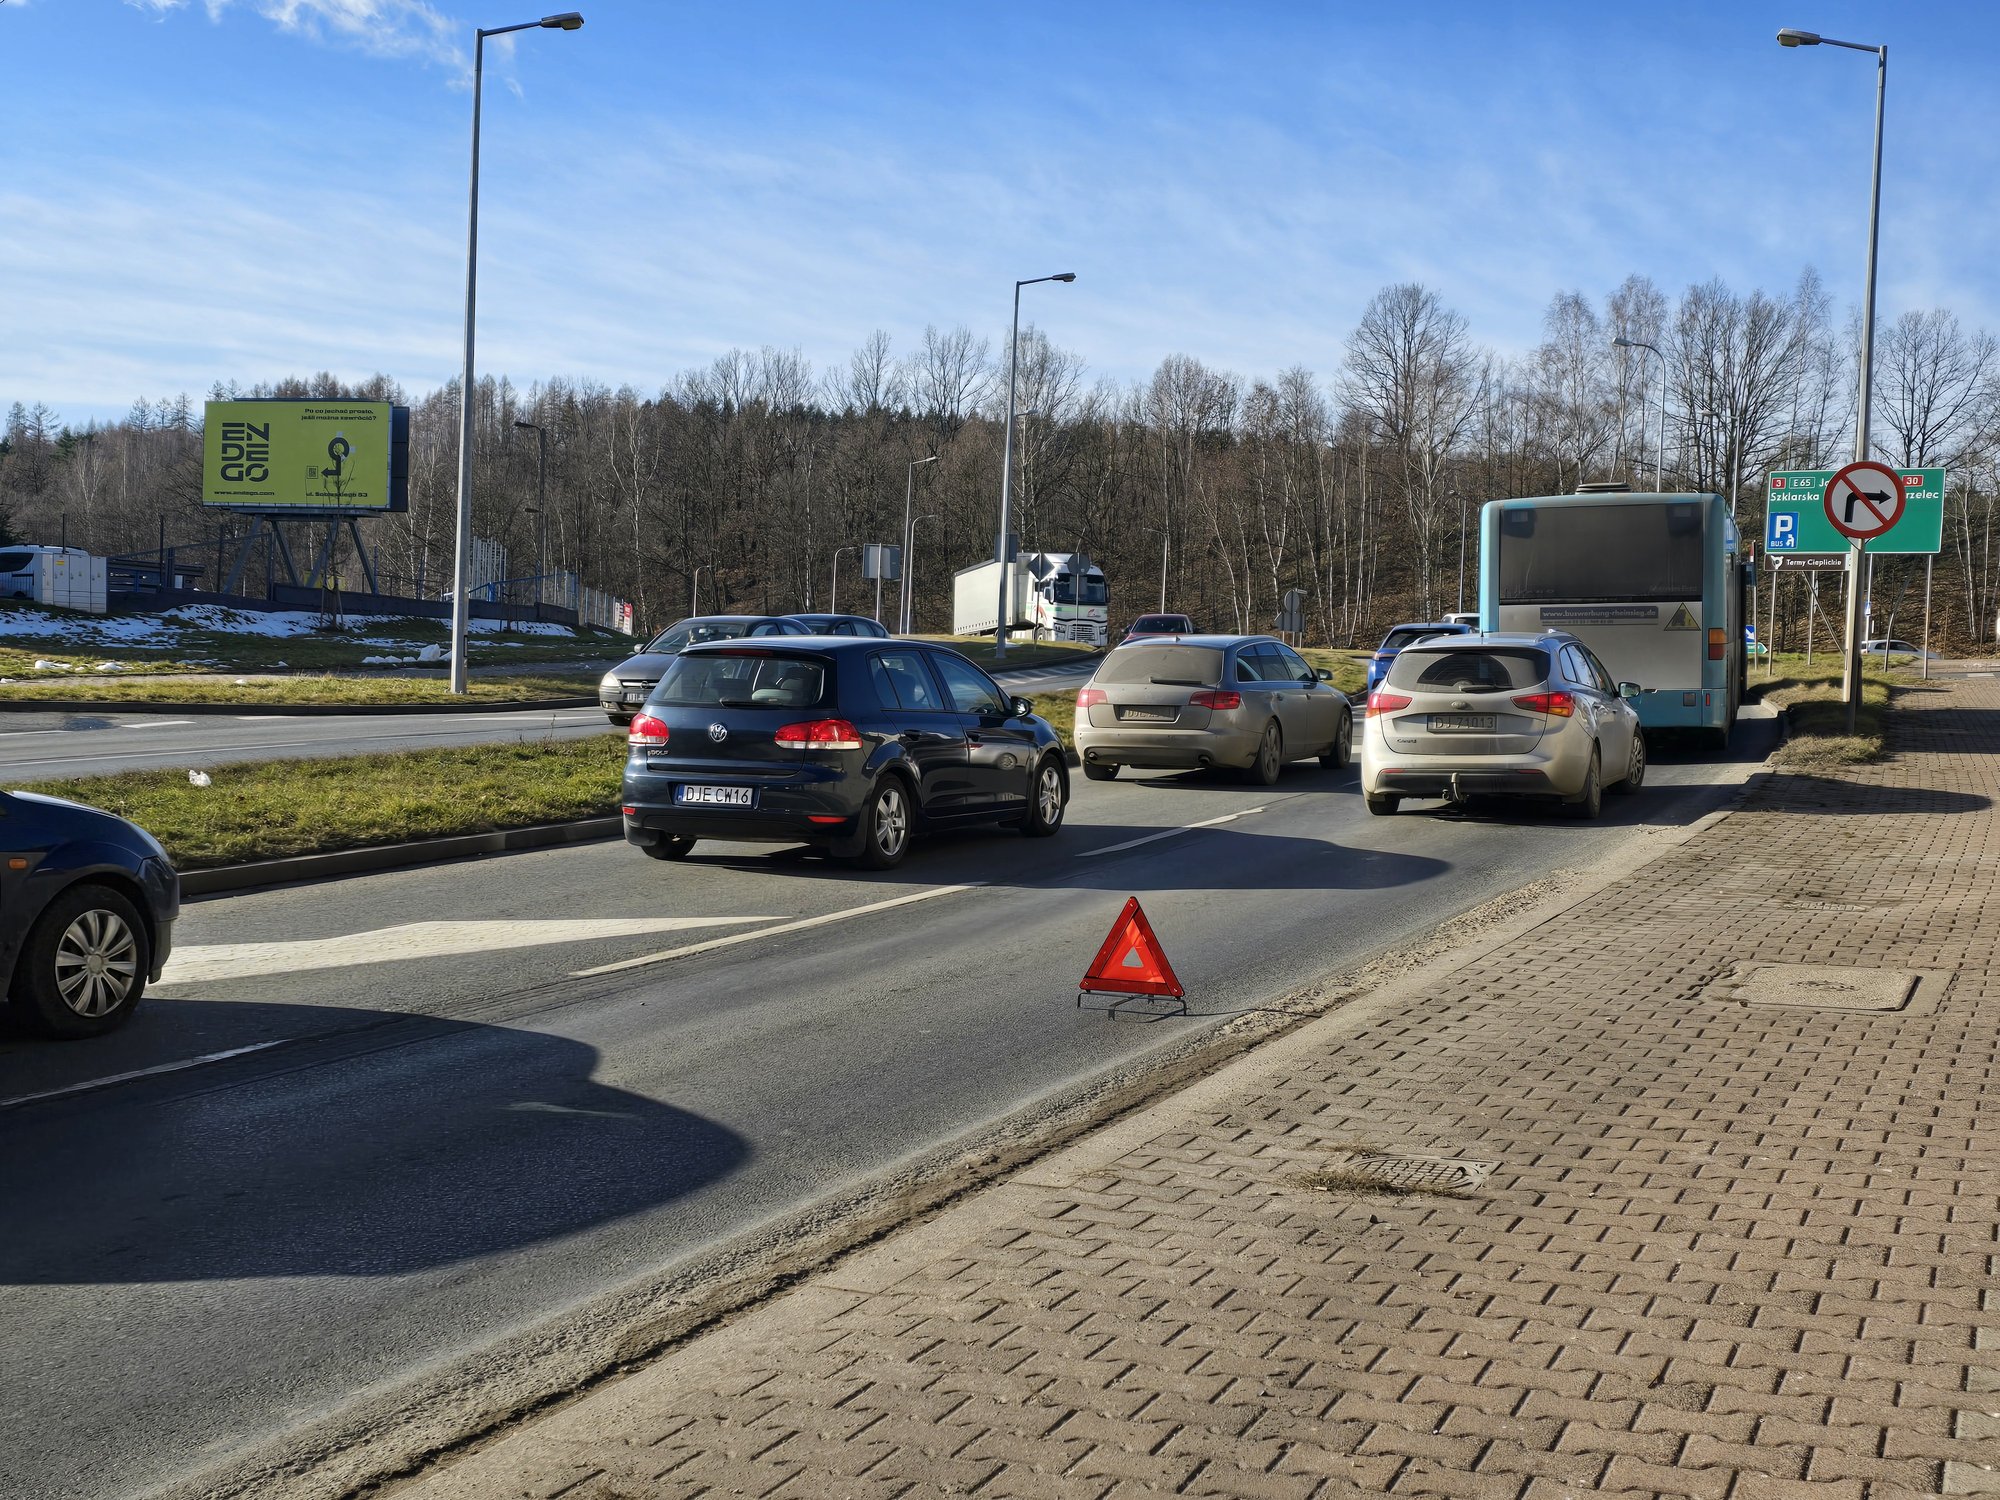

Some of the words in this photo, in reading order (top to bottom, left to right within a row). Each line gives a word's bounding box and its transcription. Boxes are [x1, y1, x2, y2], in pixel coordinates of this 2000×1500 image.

[1794, 479, 1799, 487] E
[1800, 479, 1811, 487] 65
[1906, 477, 1919, 485] 30
[1770, 491, 1820, 501] Szklarska
[1775, 515, 1793, 539] P
[1786, 559, 1806, 567] Termy
[1807, 558, 1842, 567] Cieplickie
[1435, 715, 1451, 729] DJ
[1456, 717, 1494, 729] 71013
[686, 786, 712, 802] DJE
[715, 788, 749, 804] CW16
